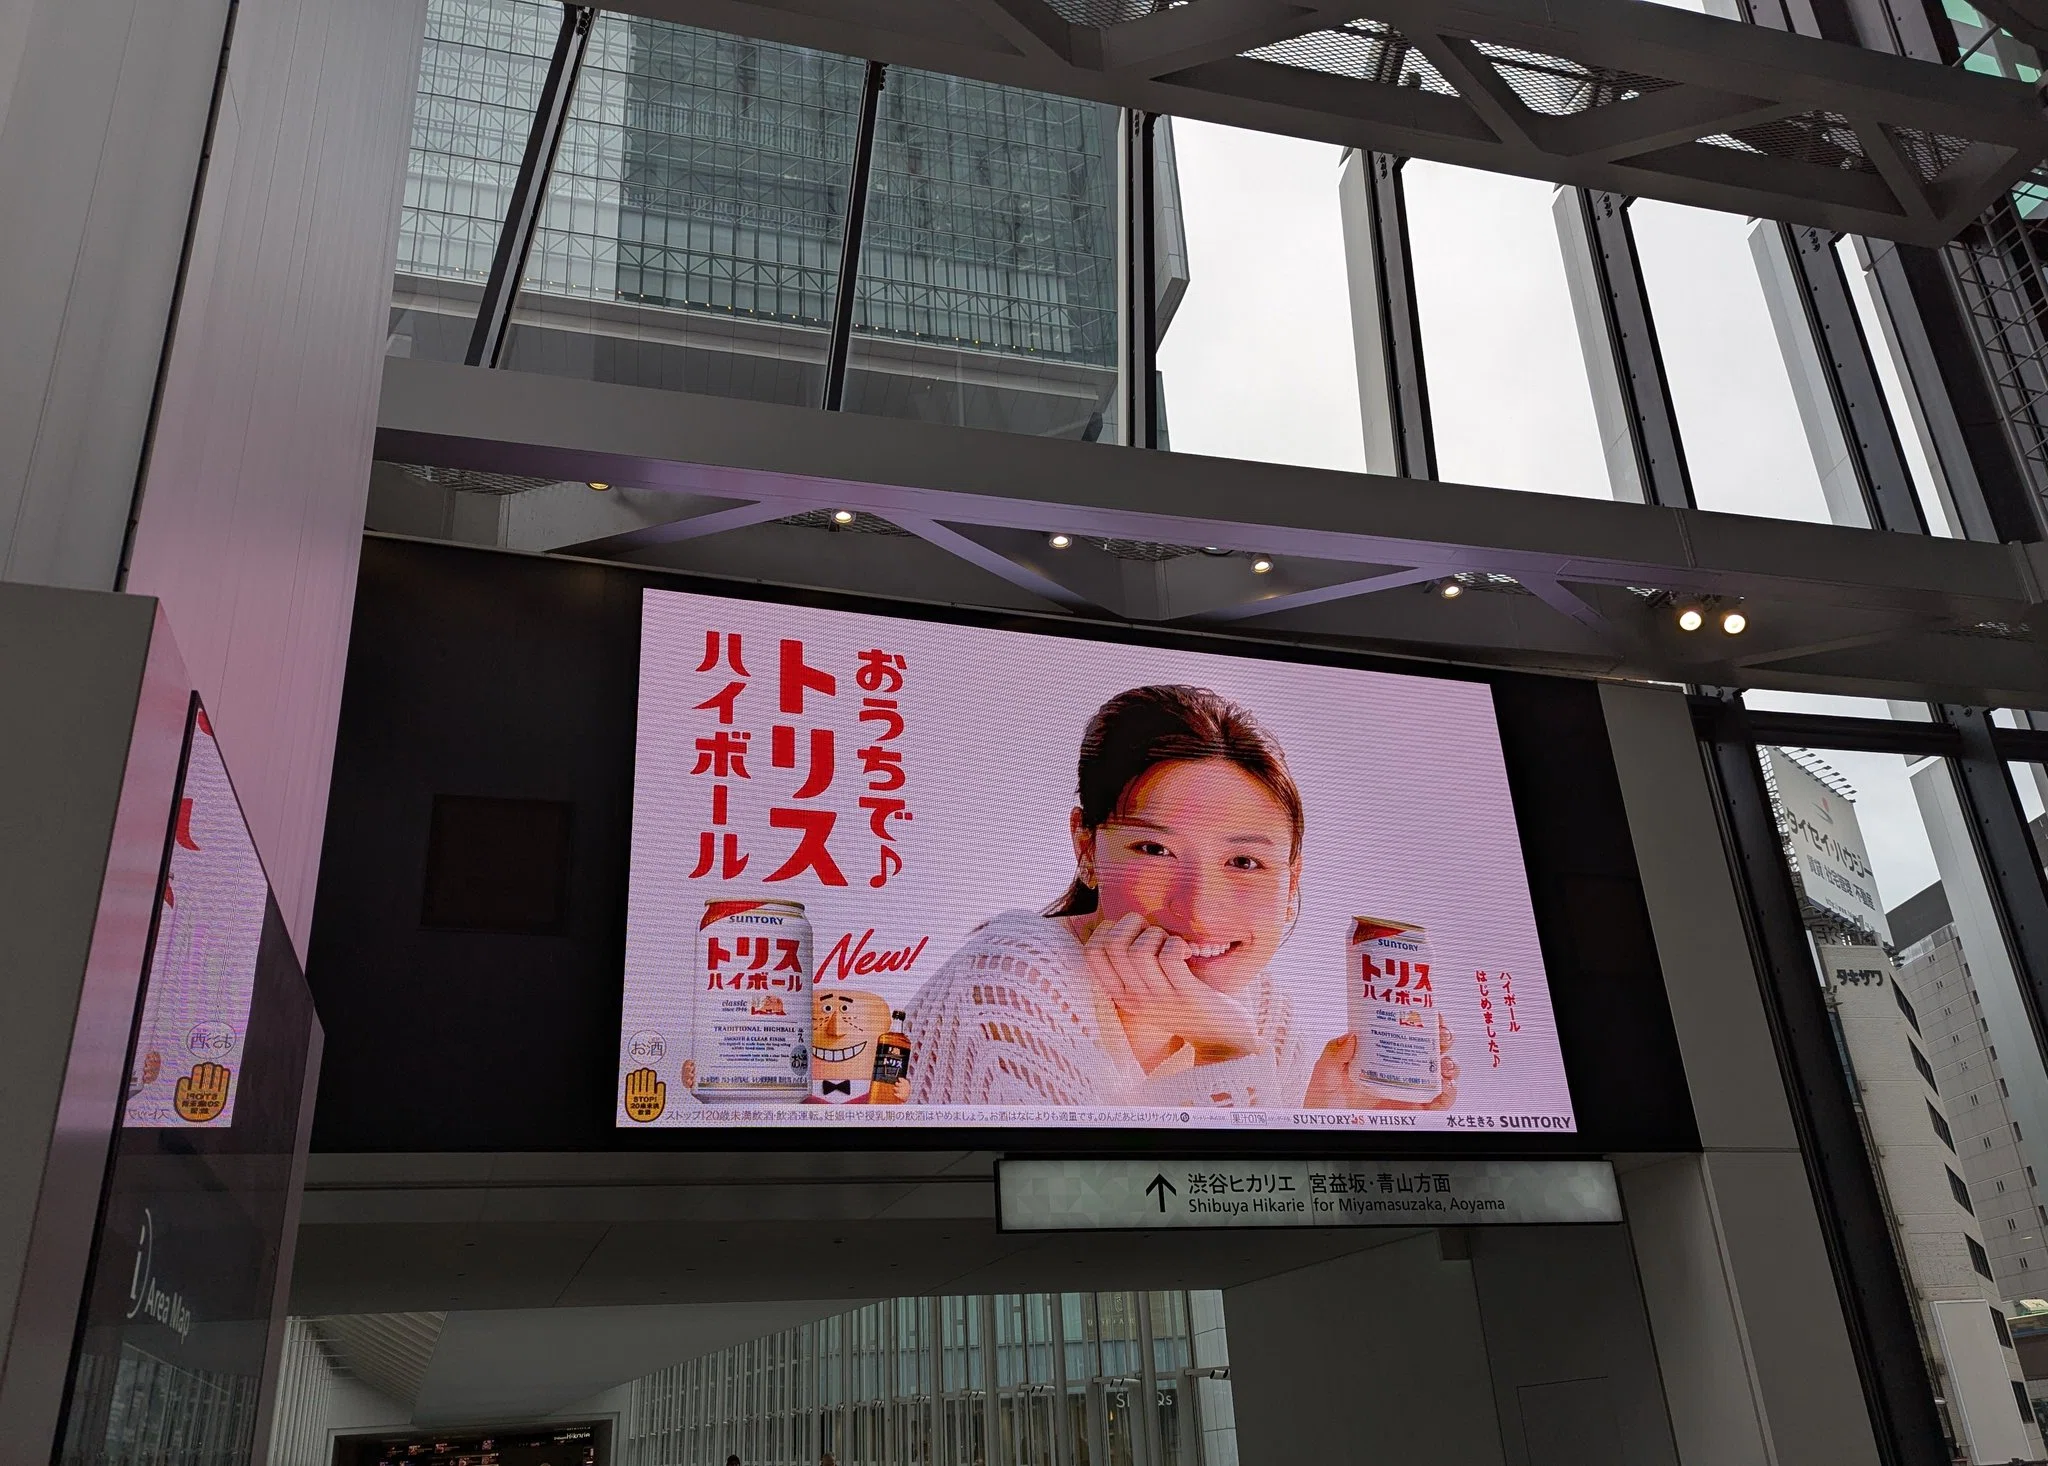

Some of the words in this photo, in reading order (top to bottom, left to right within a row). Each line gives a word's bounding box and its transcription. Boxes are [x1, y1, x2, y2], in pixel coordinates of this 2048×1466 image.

[688, 630, 752, 880] ハイボール
[762, 639, 849, 887] トリス
[729, 915, 784, 926] SUNTORY
[707, 936, 803, 973] トリス
[1378, 938, 1418, 952] SUNTORY
[813, 928, 929, 985] New!
[707, 972, 803, 993] ハイボール
[1362, 953, 1433, 992] トリス
[1836, 968, 1884, 987] タキザワ
[721, 999, 748, 1007] classic
[1363, 984, 1433, 1008] ハイボール
[1500, 972, 1521, 1032] ハイボール
[631, 1040, 663, 1056] お酒
[1369, 1115, 1416, 1126] WHISKY
[1446, 1114, 1495, 1128] 水と生きる
[1499, 1115, 1571, 1129] SUNTORY
[1188, 1172, 1296, 1195] 渋谷ヒカリエ
[1309, 1172, 1451, 1195] 宮益坂・青山方面
[1188, 1197, 1249, 1217] Shibuya
[1253, 1197, 1305, 1213] Hikarie
[1313, 1197, 1335, 1212] for
[1338, 1197, 1447, 1215] Miyamasuzaka,
[1450, 1197, 1506, 1214] Aoyama
[144, 1276, 170, 1325] Area
[169, 1291, 191, 1345] Map
